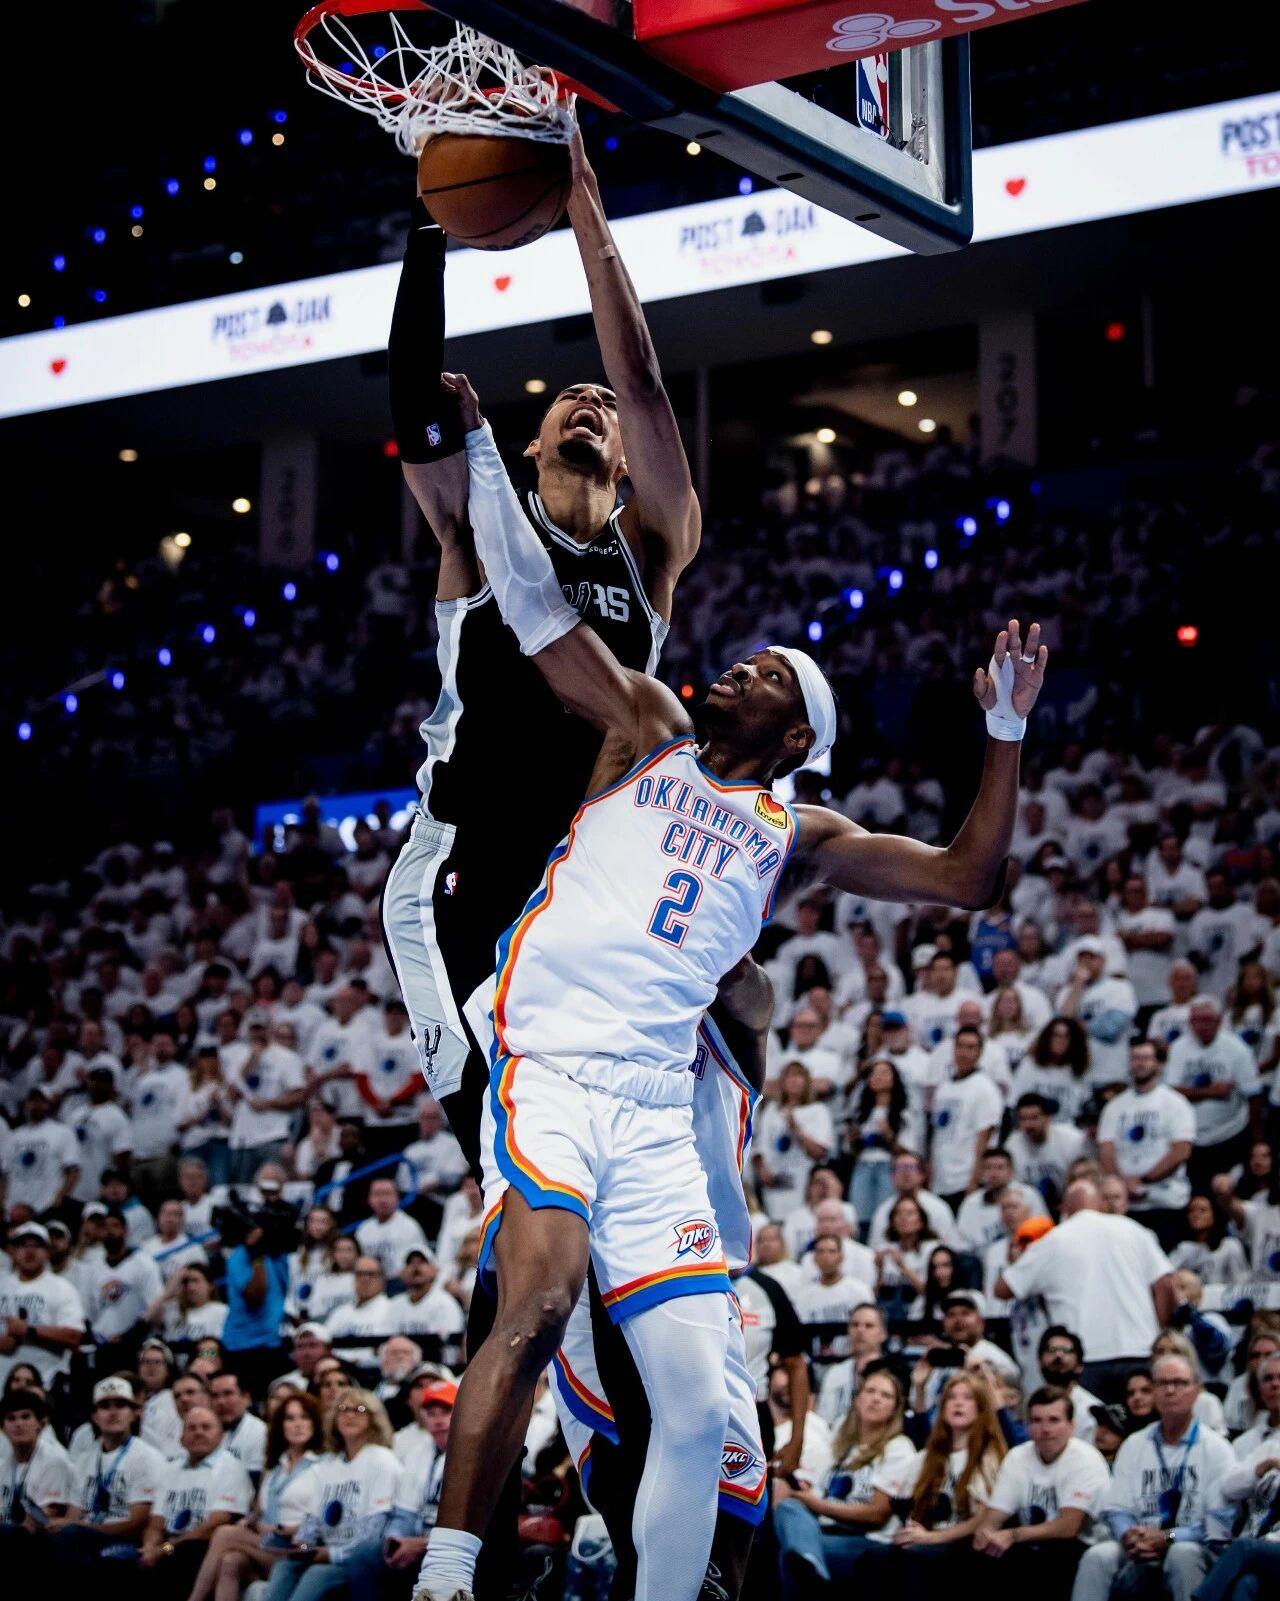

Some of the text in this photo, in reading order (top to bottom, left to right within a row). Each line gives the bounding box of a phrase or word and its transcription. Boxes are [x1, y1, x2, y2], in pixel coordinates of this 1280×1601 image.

[634, 775, 782, 880] OKLAHOMA
[660, 821, 740, 880] CITY
[647, 868, 704, 949] 2
[678, 1226, 710, 1251] OKC
